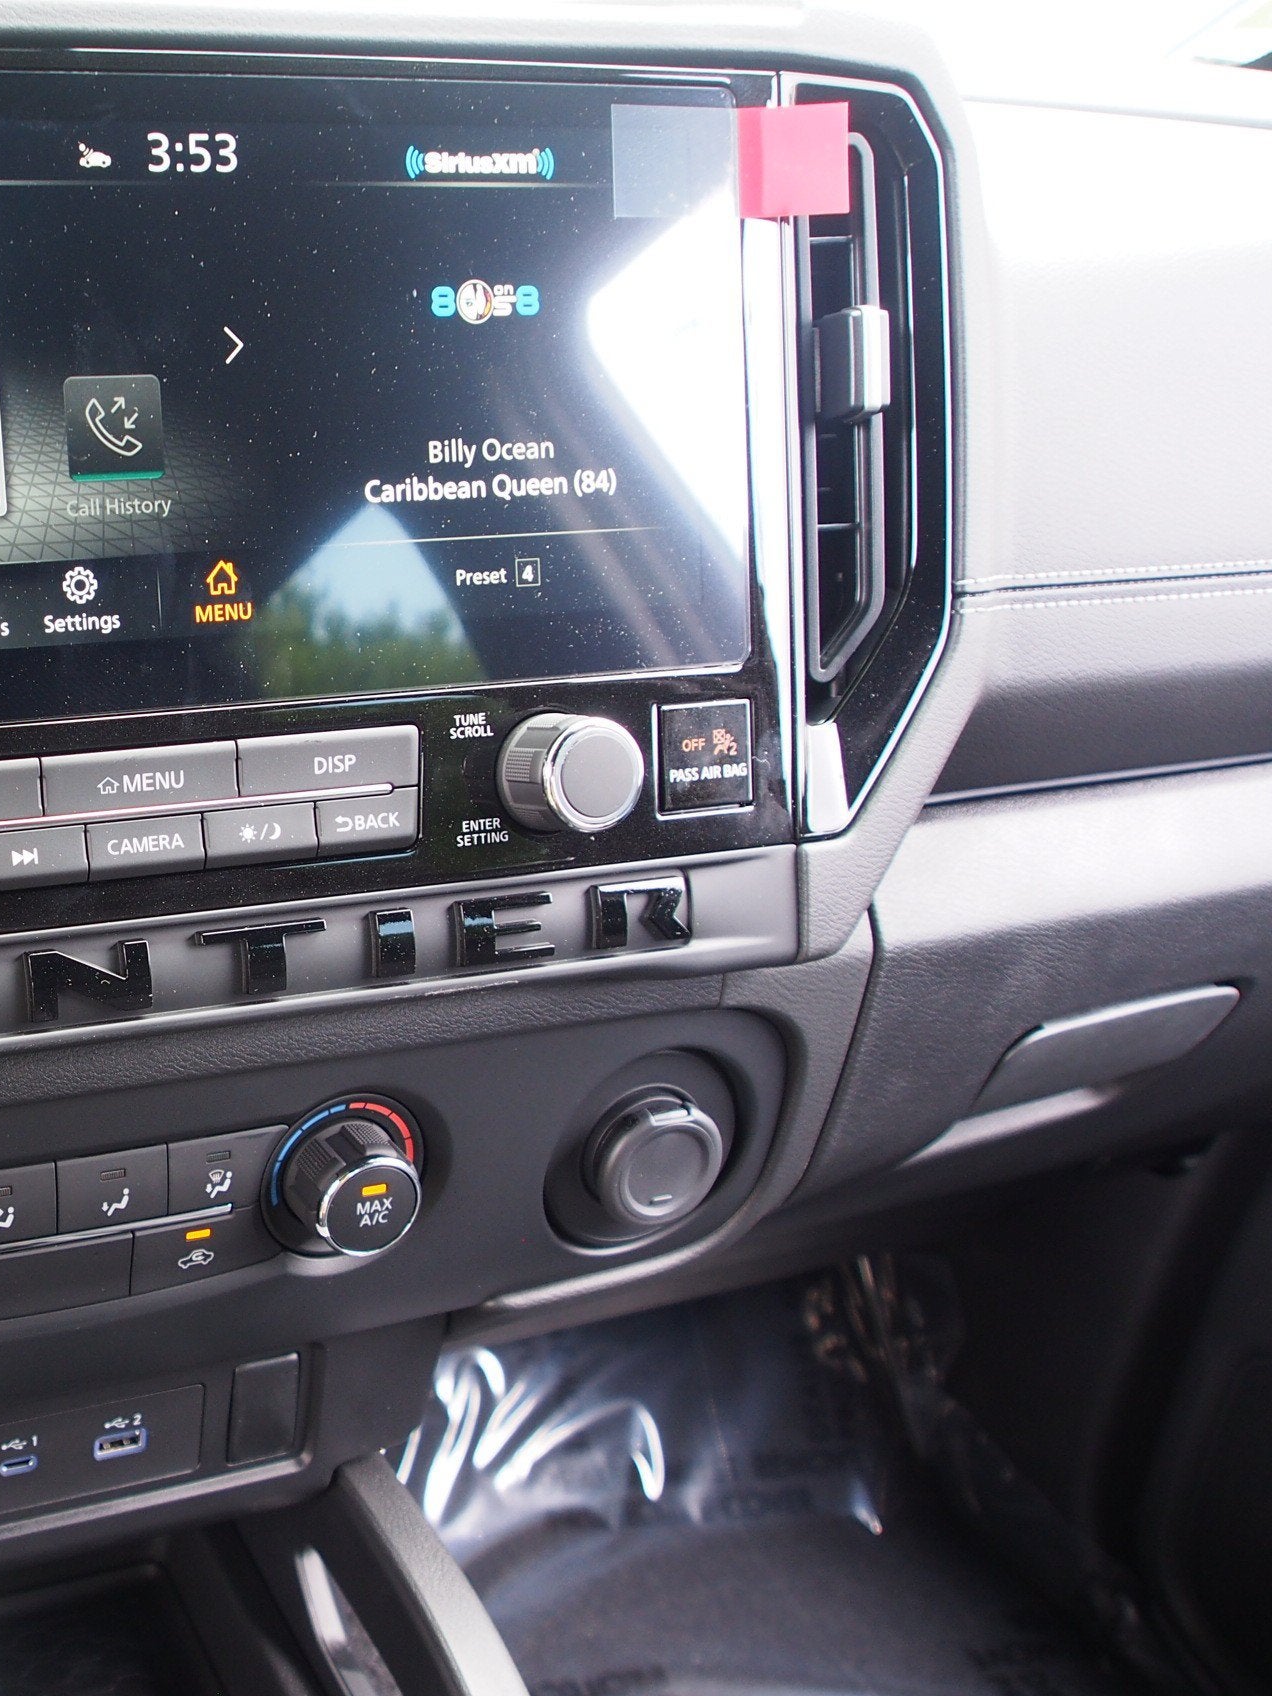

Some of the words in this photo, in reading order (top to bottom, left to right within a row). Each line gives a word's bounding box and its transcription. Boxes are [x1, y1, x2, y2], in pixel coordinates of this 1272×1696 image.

[146, 132, 239, 173] 3:53
[427, 438, 476, 468] Billy
[481, 438, 555, 462] Ocean
[363, 475, 487, 504] Caribbean
[491, 471, 569, 500] Queen
[573, 468, 618, 497] (84)
[66, 498, 103, 518] Call
[105, 496, 172, 520] History
[454, 567, 508, 588] Preset
[520, 564, 535, 584] 4
[42, 611, 121, 636] Settings
[194, 602, 254, 624] MENU
[453, 711, 487, 727] TUNE
[448, 723, 495, 740] SCROLL
[681, 737, 707, 753] OFF
[313, 753, 358, 776] DISP
[668, 766, 700, 784] PASS
[700, 764, 723, 781] AIR
[722, 762, 748, 779] BAG
[122, 769, 186, 794] MENU
[353, 810, 400, 832] BACK
[460, 816, 502, 833] ENTER
[106, 833, 185, 857] CAMERA
[455, 829, 510, 848] SETTING
[355, 1196, 394, 1217] MAX
[358, 1210, 390, 1228] A/C
